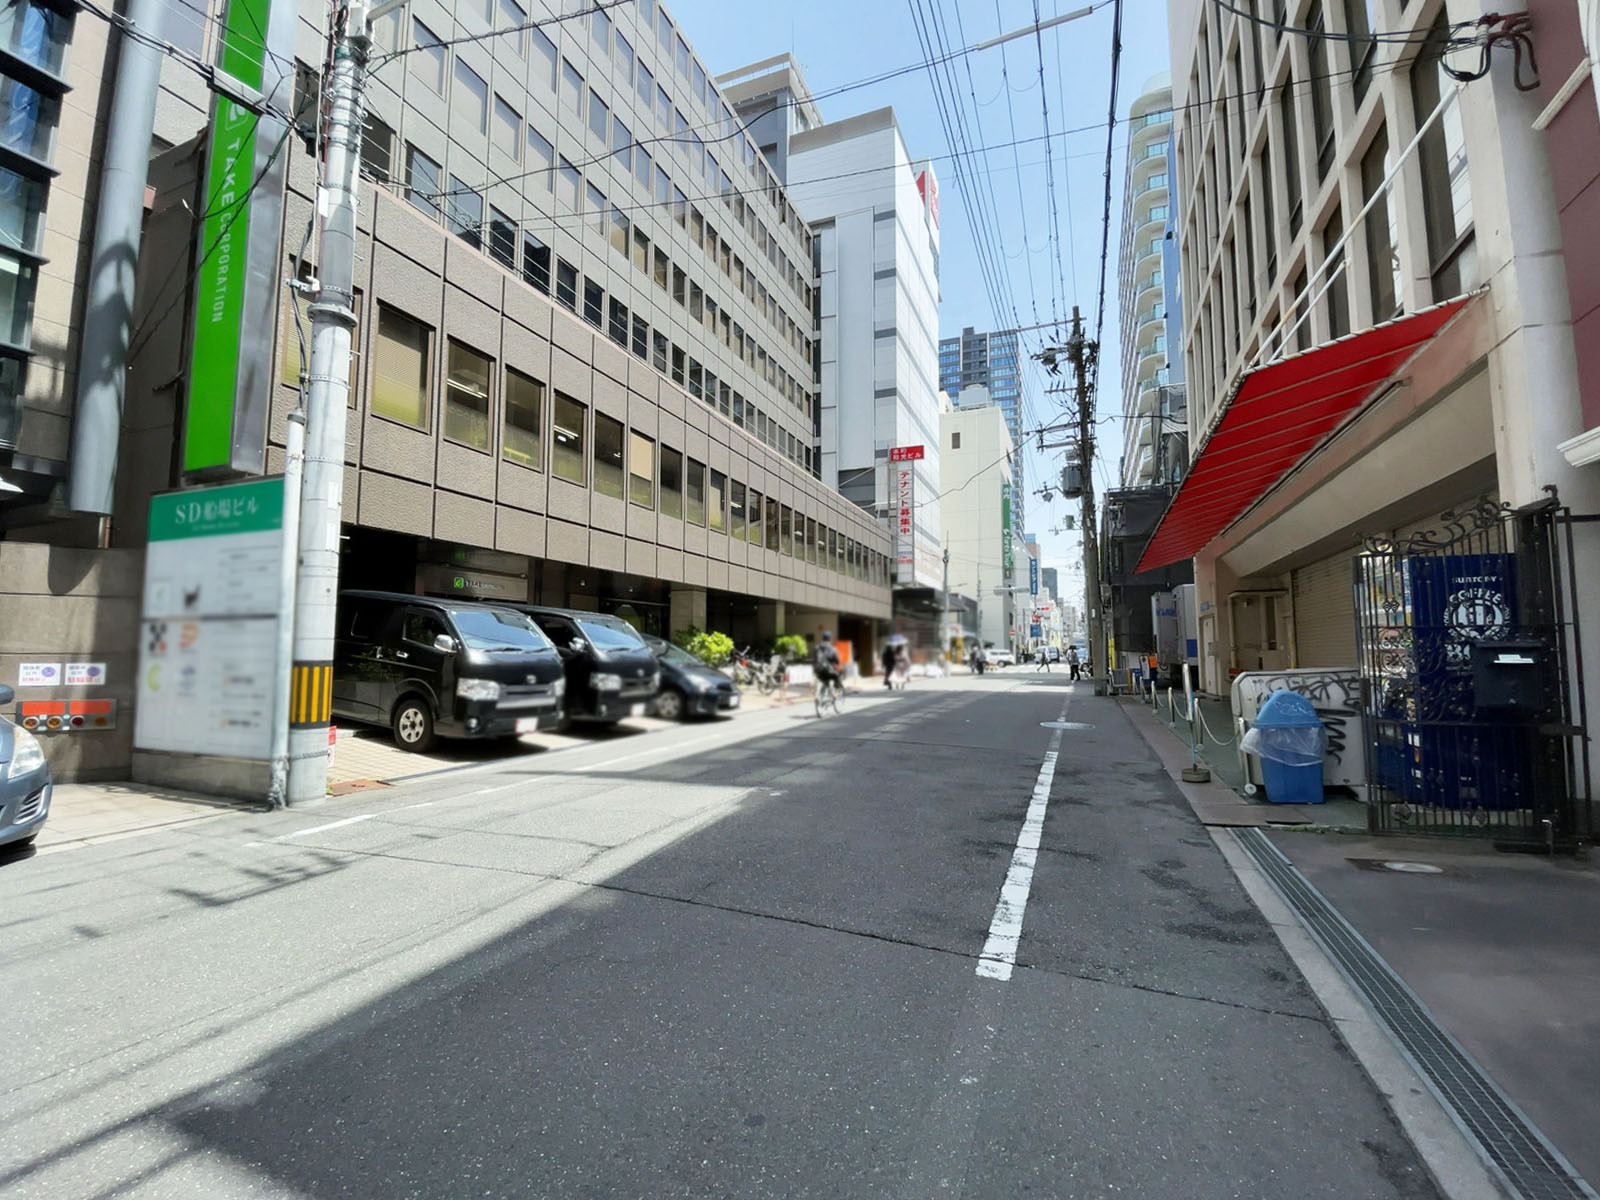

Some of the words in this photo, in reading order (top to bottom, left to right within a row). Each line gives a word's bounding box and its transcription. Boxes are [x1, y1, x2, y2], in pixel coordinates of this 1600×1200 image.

[221, 138, 241, 207] TAKE
[212, 212, 232, 323] CORPORATION
[900, 471, 910, 534] テナント募集中
